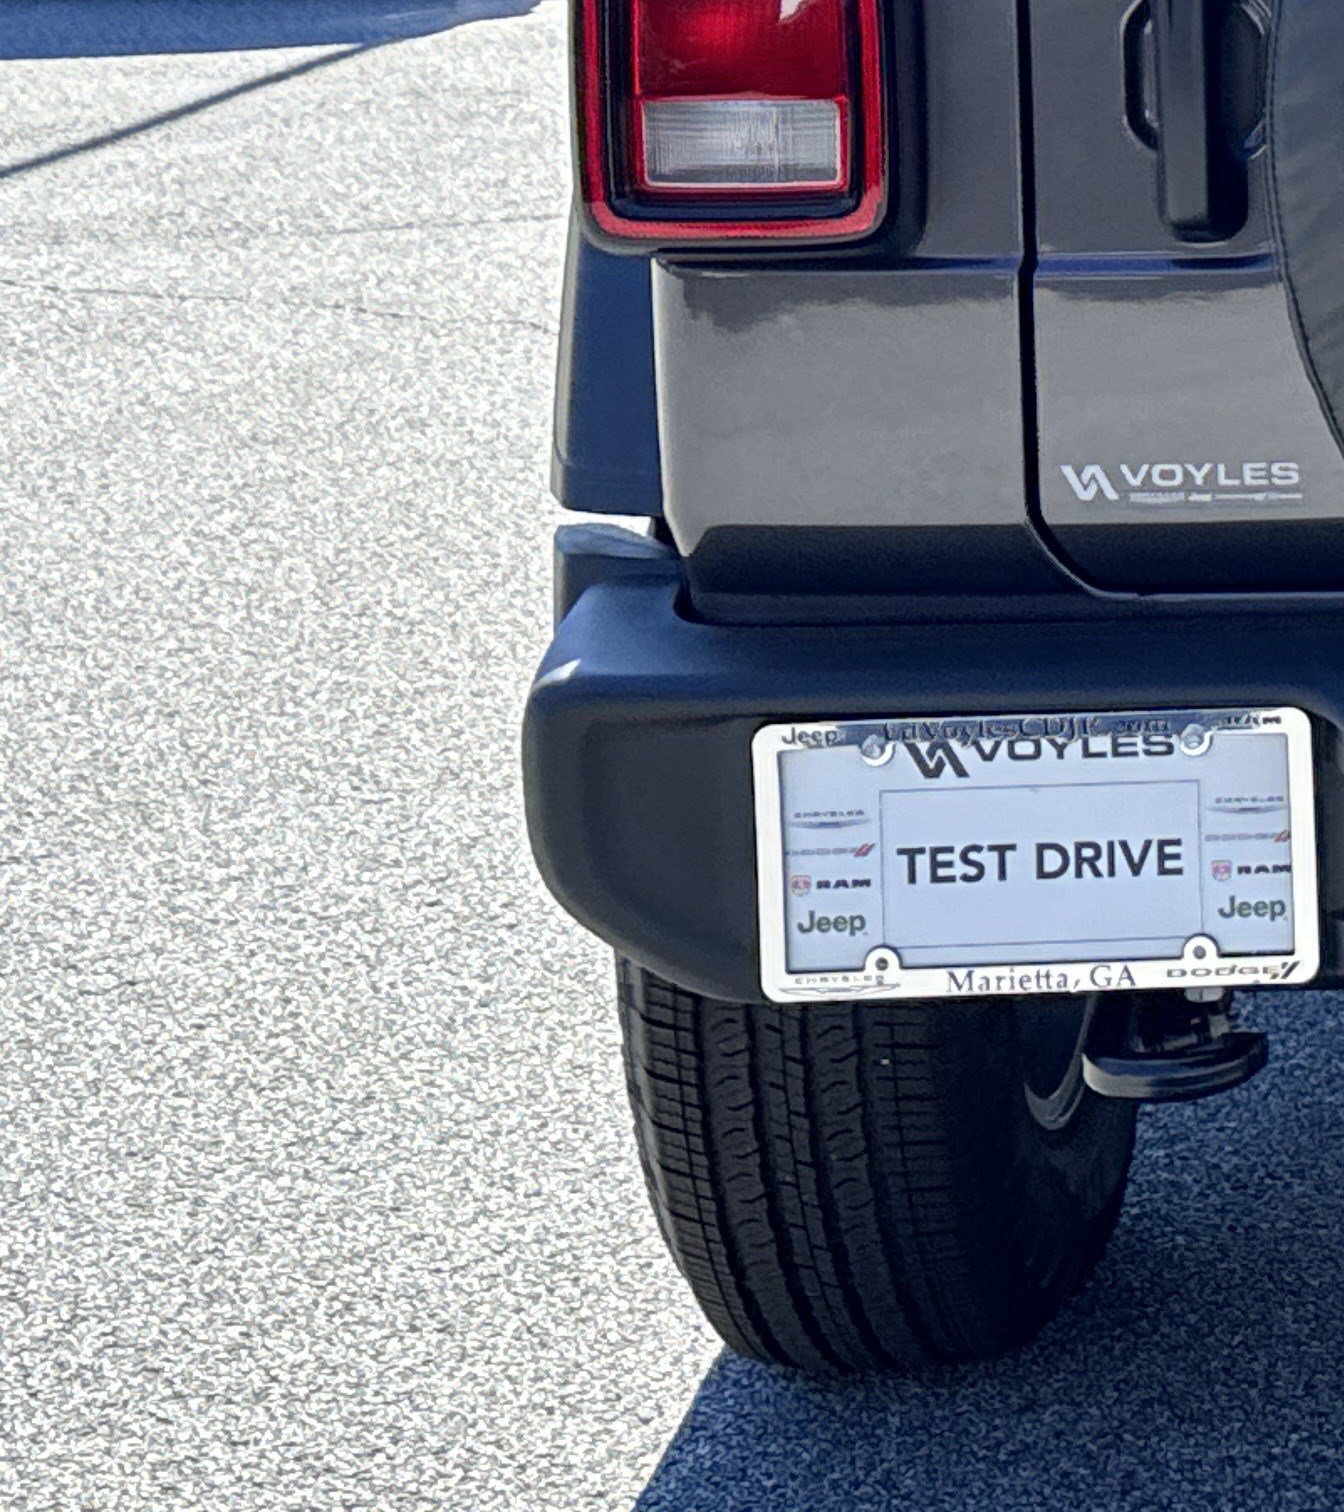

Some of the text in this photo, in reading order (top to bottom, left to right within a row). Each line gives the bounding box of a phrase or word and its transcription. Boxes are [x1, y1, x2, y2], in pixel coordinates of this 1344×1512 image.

[1119, 462, 1300, 487] VOYLES
[974, 735, 1175, 762] VOYLES
[897, 838, 1184, 885] TEST DRIVE
[816, 878, 872, 889] RAM
[1217, 894, 1287, 922] Jeep
[797, 909, 867, 937] Jeep
[945, 964, 1137, 992] Marietta, GA
